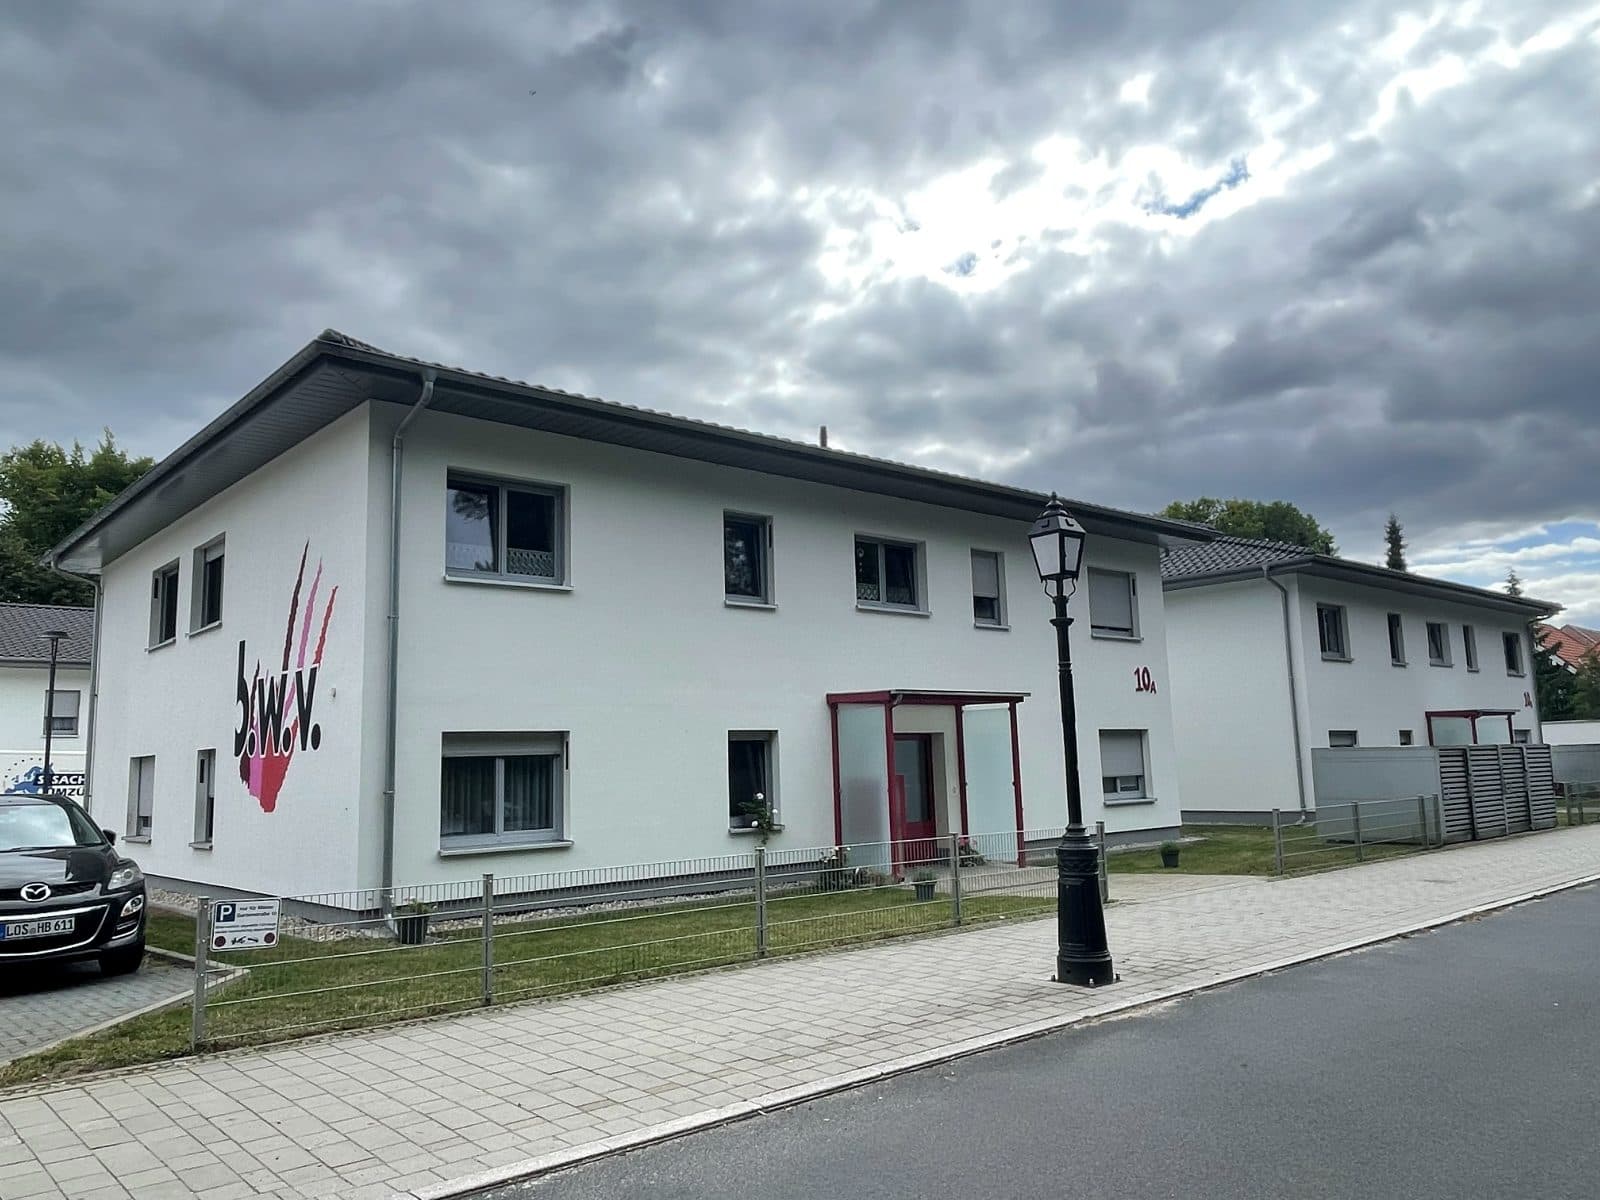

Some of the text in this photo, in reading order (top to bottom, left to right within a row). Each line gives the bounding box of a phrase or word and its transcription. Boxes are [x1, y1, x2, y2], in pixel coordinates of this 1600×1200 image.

[6, 919, 73, 937] LOS HB 611
